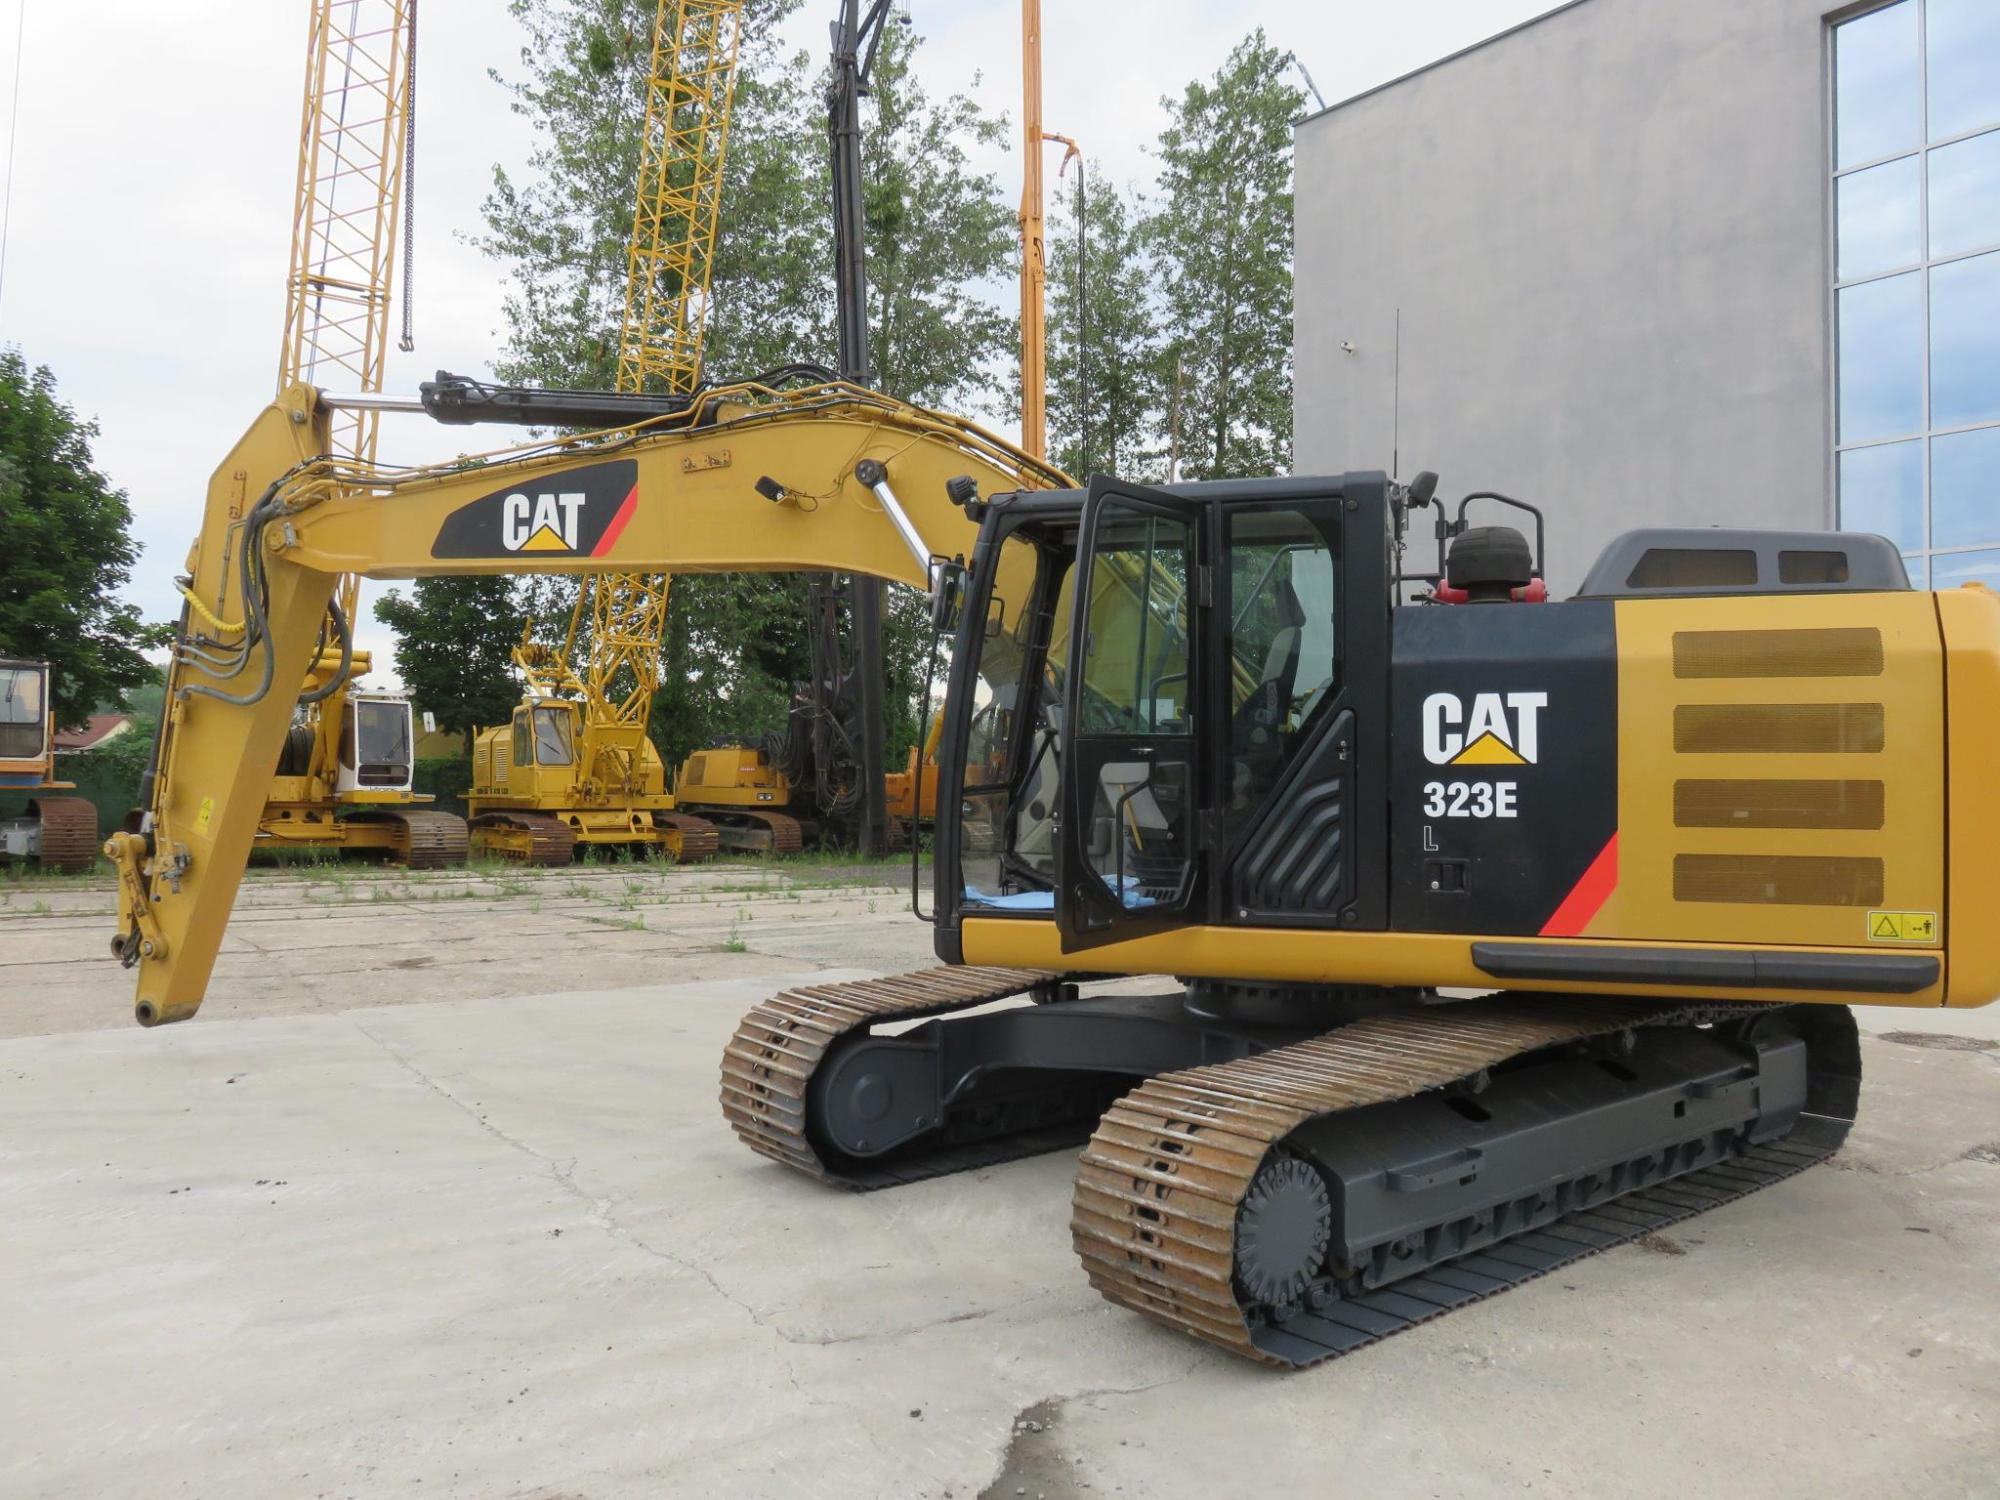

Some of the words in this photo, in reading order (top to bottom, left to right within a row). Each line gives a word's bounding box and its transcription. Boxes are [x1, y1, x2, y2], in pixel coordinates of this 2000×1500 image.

[503, 493, 585, 551] CAT
[1423, 692, 1548, 765] CAT
[1423, 781, 1518, 818] 323E
[1424, 825, 1439, 851] L
